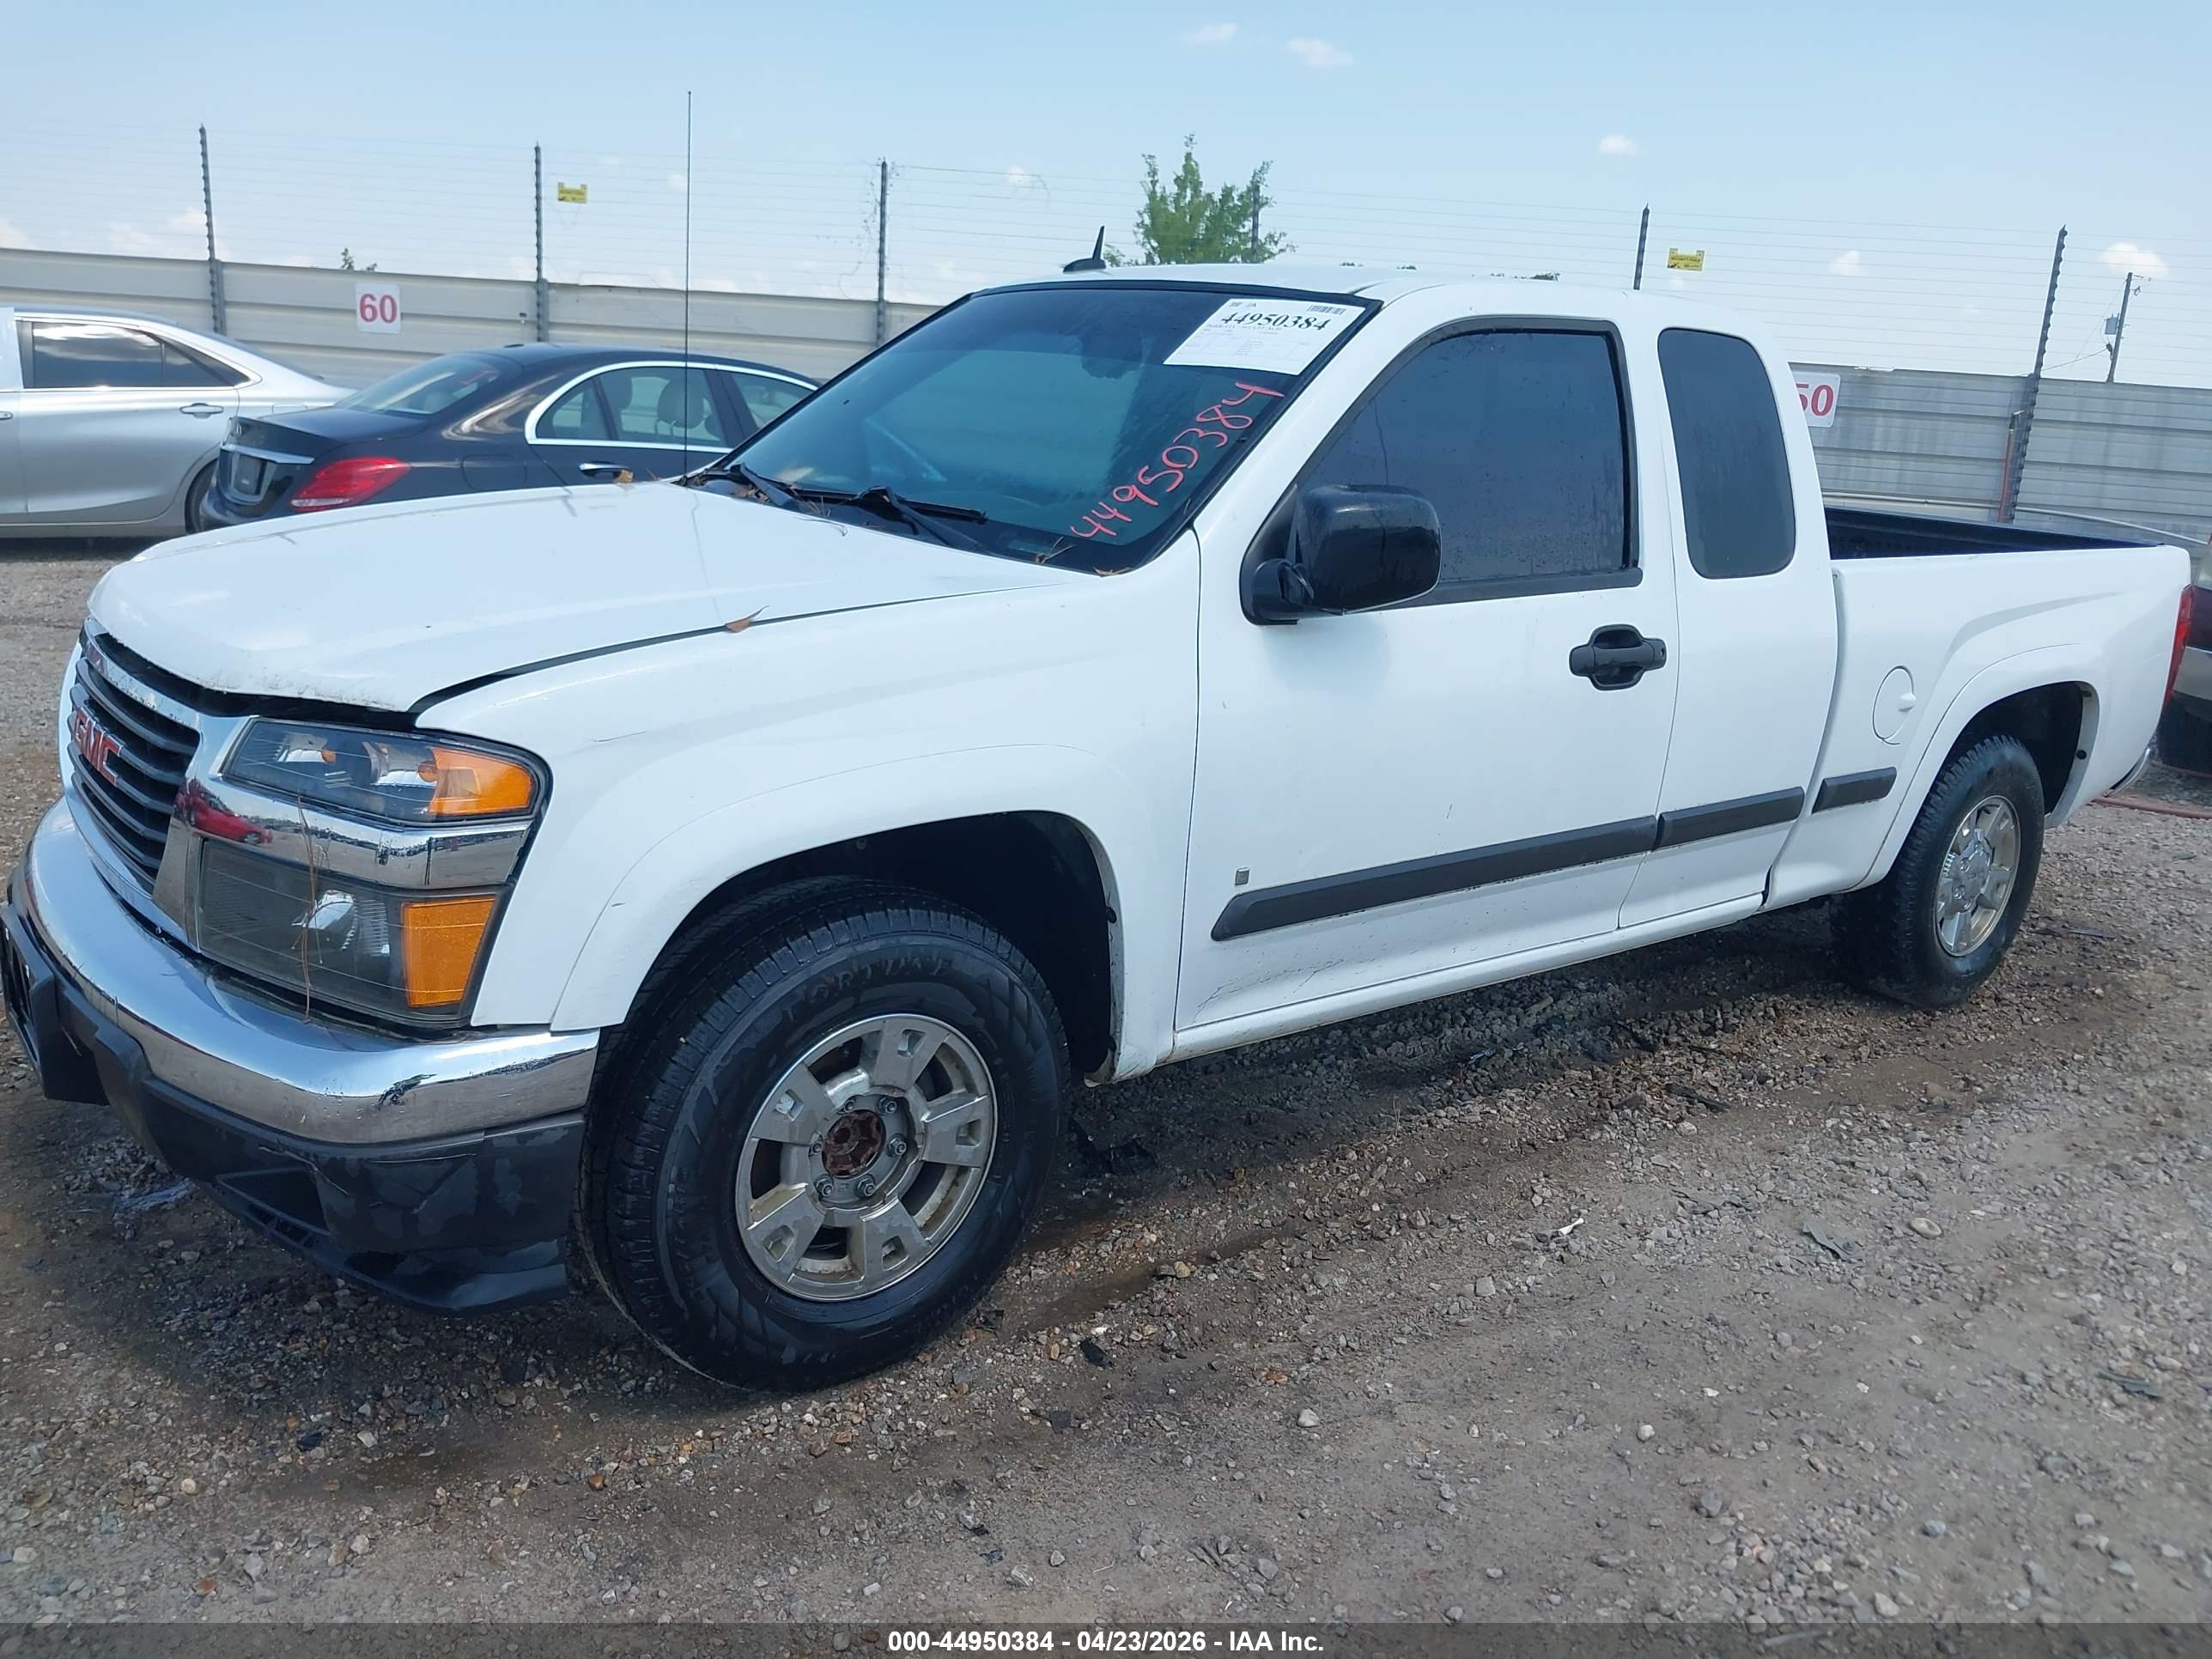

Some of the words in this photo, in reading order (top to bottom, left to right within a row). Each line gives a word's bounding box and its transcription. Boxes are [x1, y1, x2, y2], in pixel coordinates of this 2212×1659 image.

[359, 293, 398, 325] 60
[1221, 312, 1332, 331] 44950384
[1070, 381, 1285, 538] 44950384
[74, 706, 124, 787] GMC
